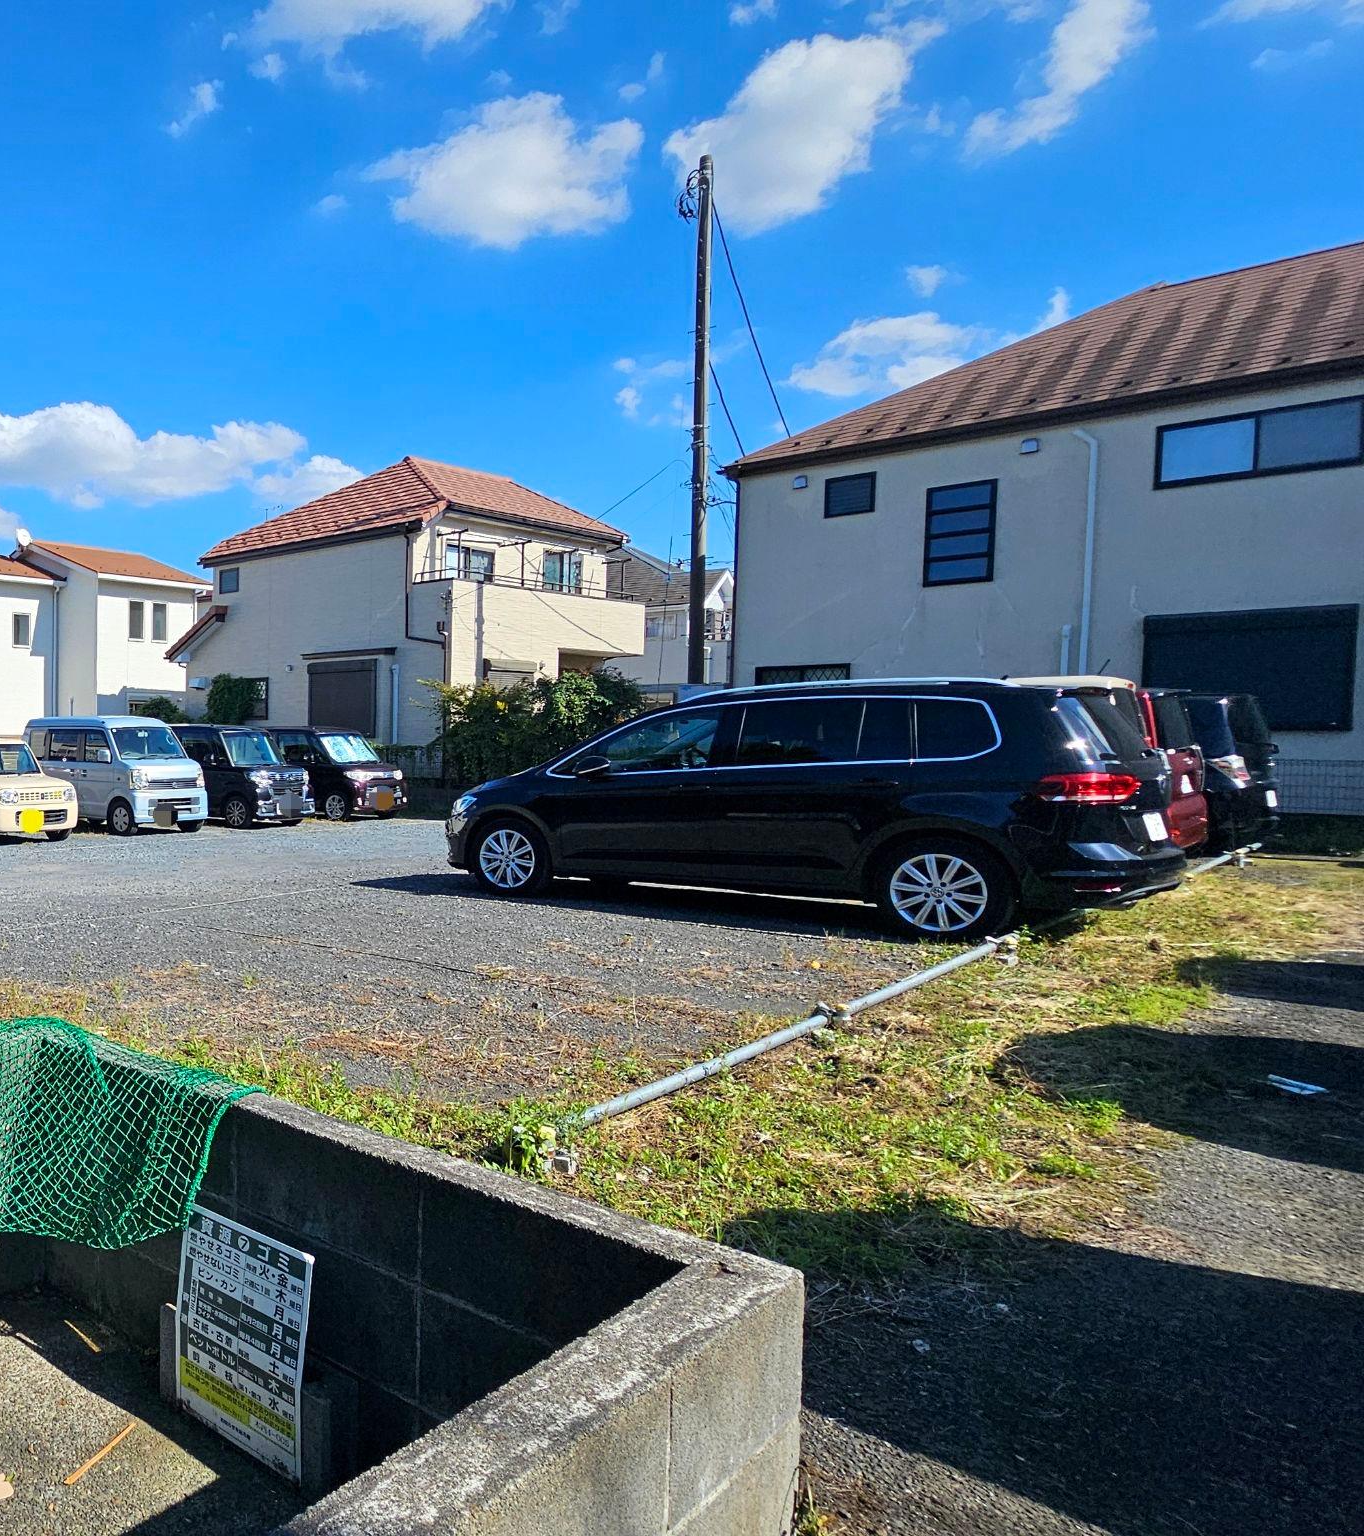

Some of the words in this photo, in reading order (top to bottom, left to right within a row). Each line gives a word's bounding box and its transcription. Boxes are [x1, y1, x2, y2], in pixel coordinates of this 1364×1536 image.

[189, 1247, 240, 1279] 燃やせないゴミ
